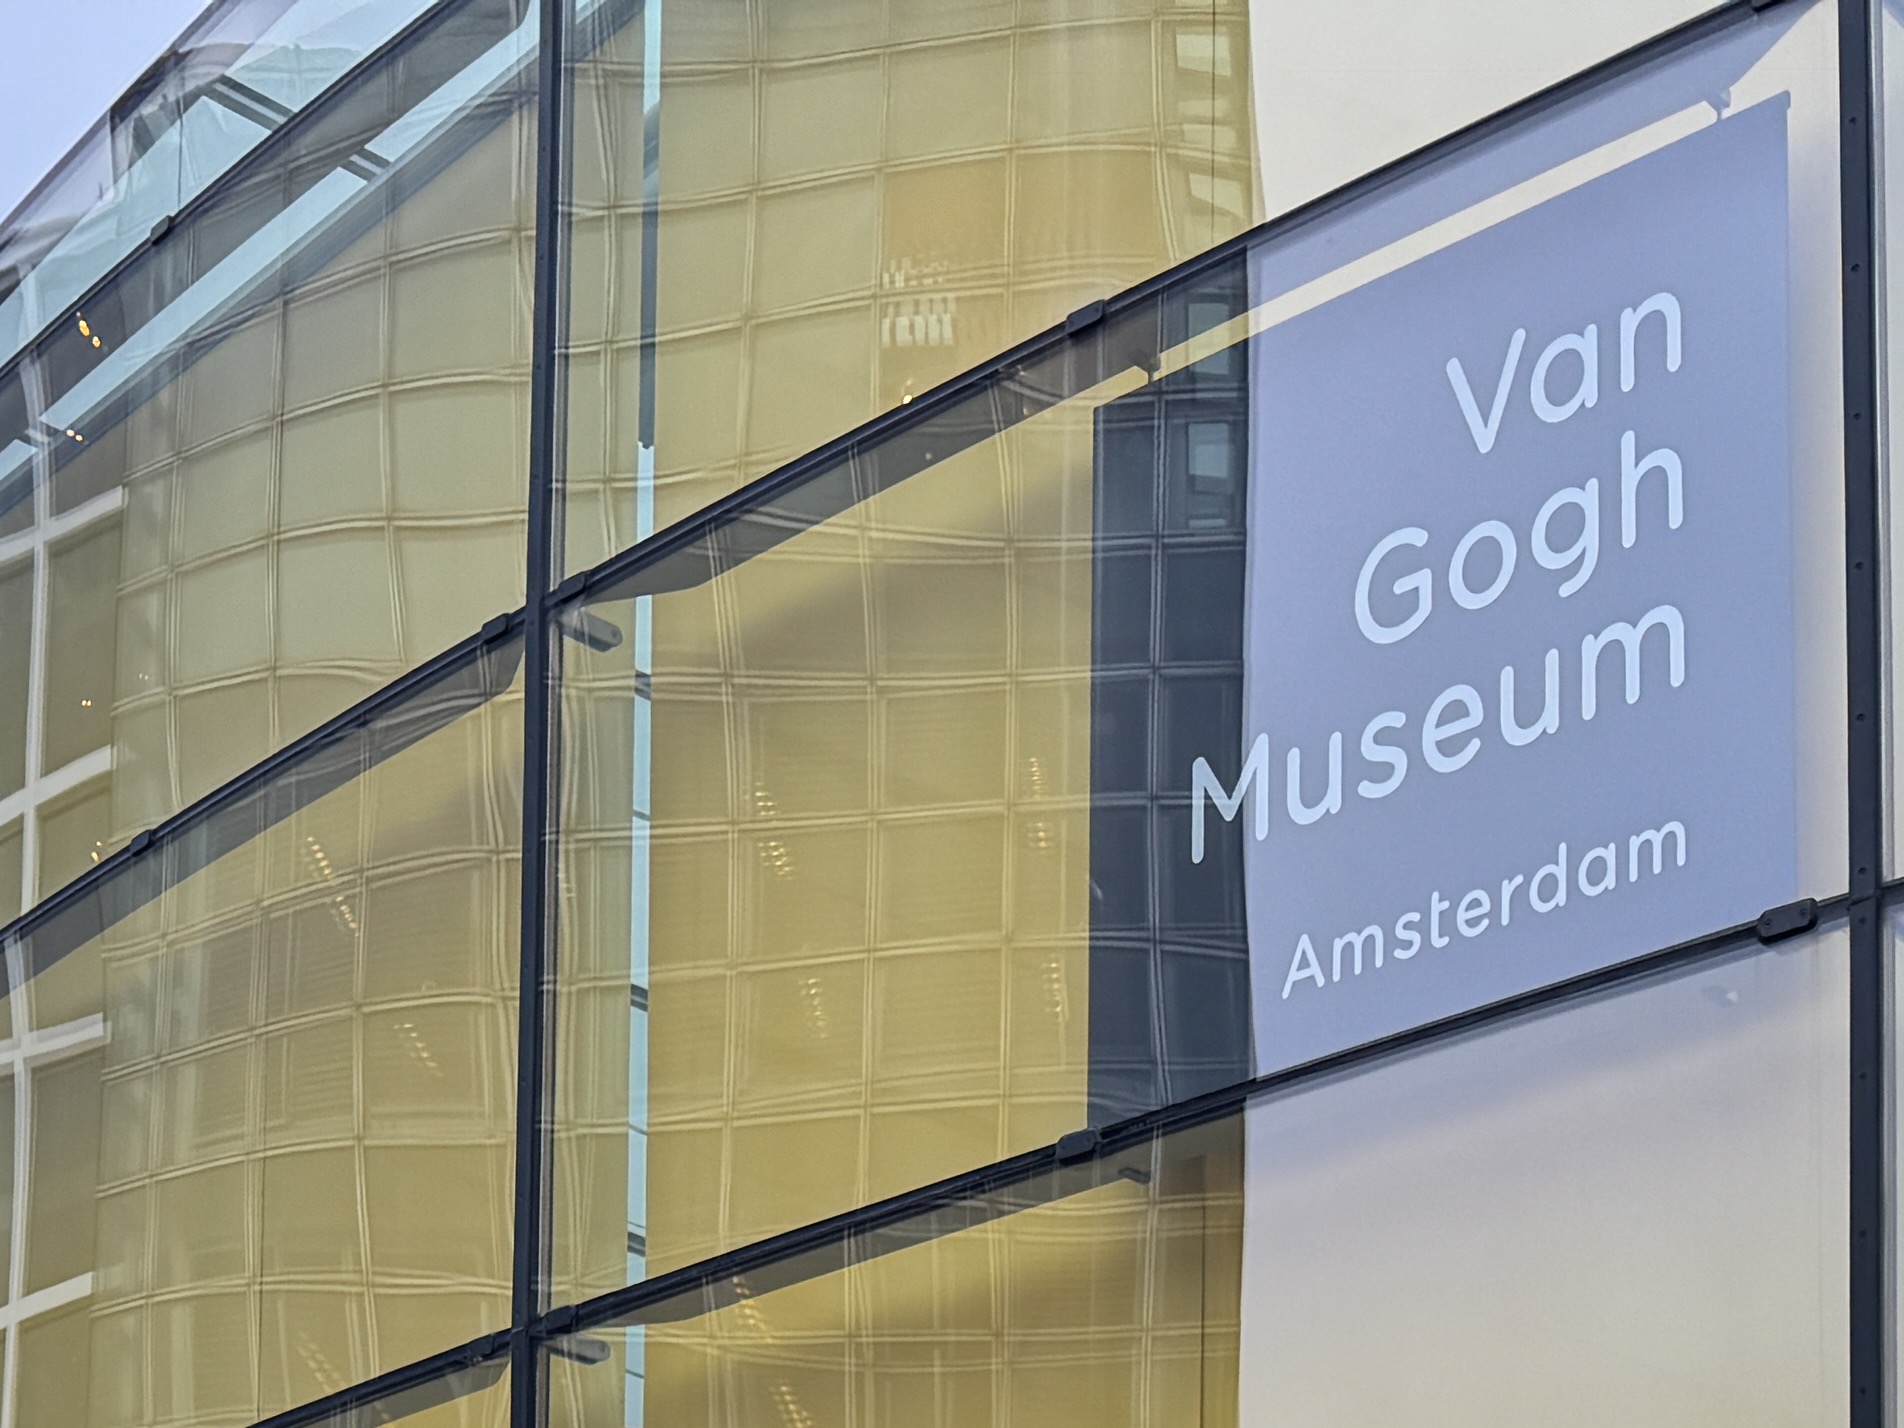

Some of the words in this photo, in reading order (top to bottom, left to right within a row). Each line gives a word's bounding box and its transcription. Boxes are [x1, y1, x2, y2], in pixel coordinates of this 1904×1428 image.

[1445, 291, 1683, 454] Van
[1353, 430, 1686, 645] Gogh
[1191, 604, 1687, 865] Museum
[1281, 819, 1688, 999] Amsterdam
